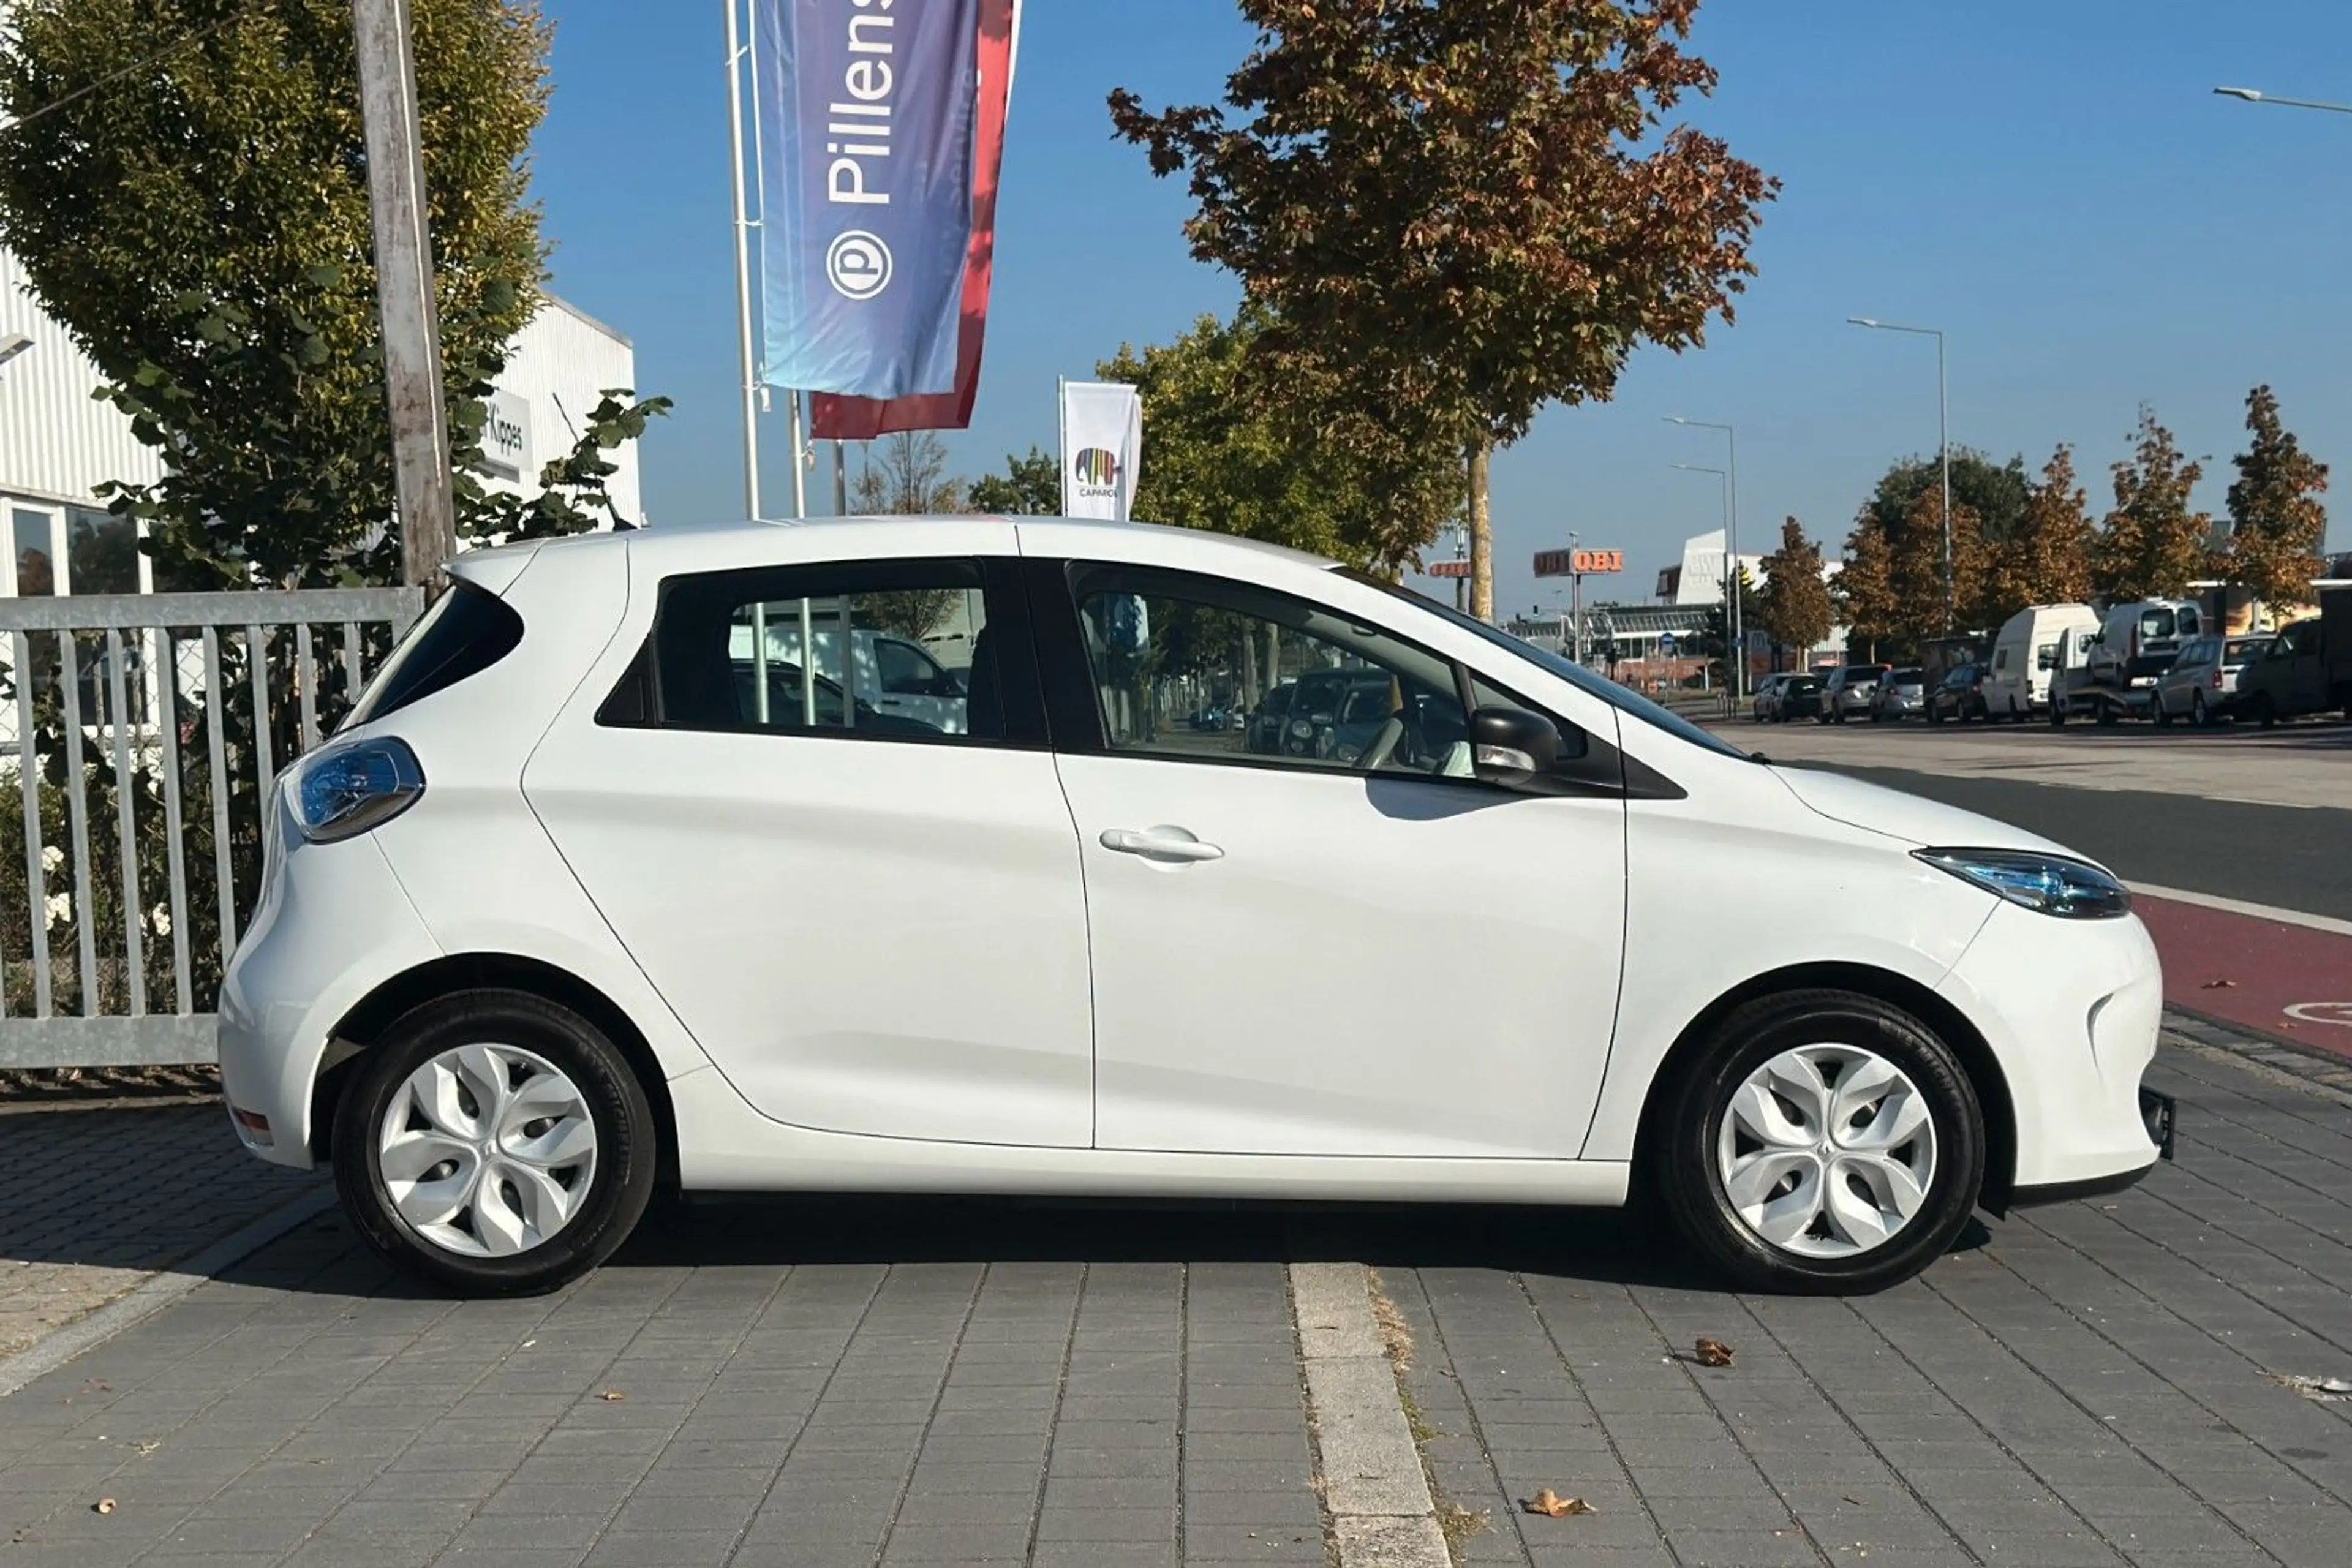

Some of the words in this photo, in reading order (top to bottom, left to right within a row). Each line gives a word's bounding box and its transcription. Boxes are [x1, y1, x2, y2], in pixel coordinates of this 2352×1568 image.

[827, 0, 894, 204] Pillen
[489, 402, 522, 457] Kippes
[1575, 551, 1623, 572] OBI
